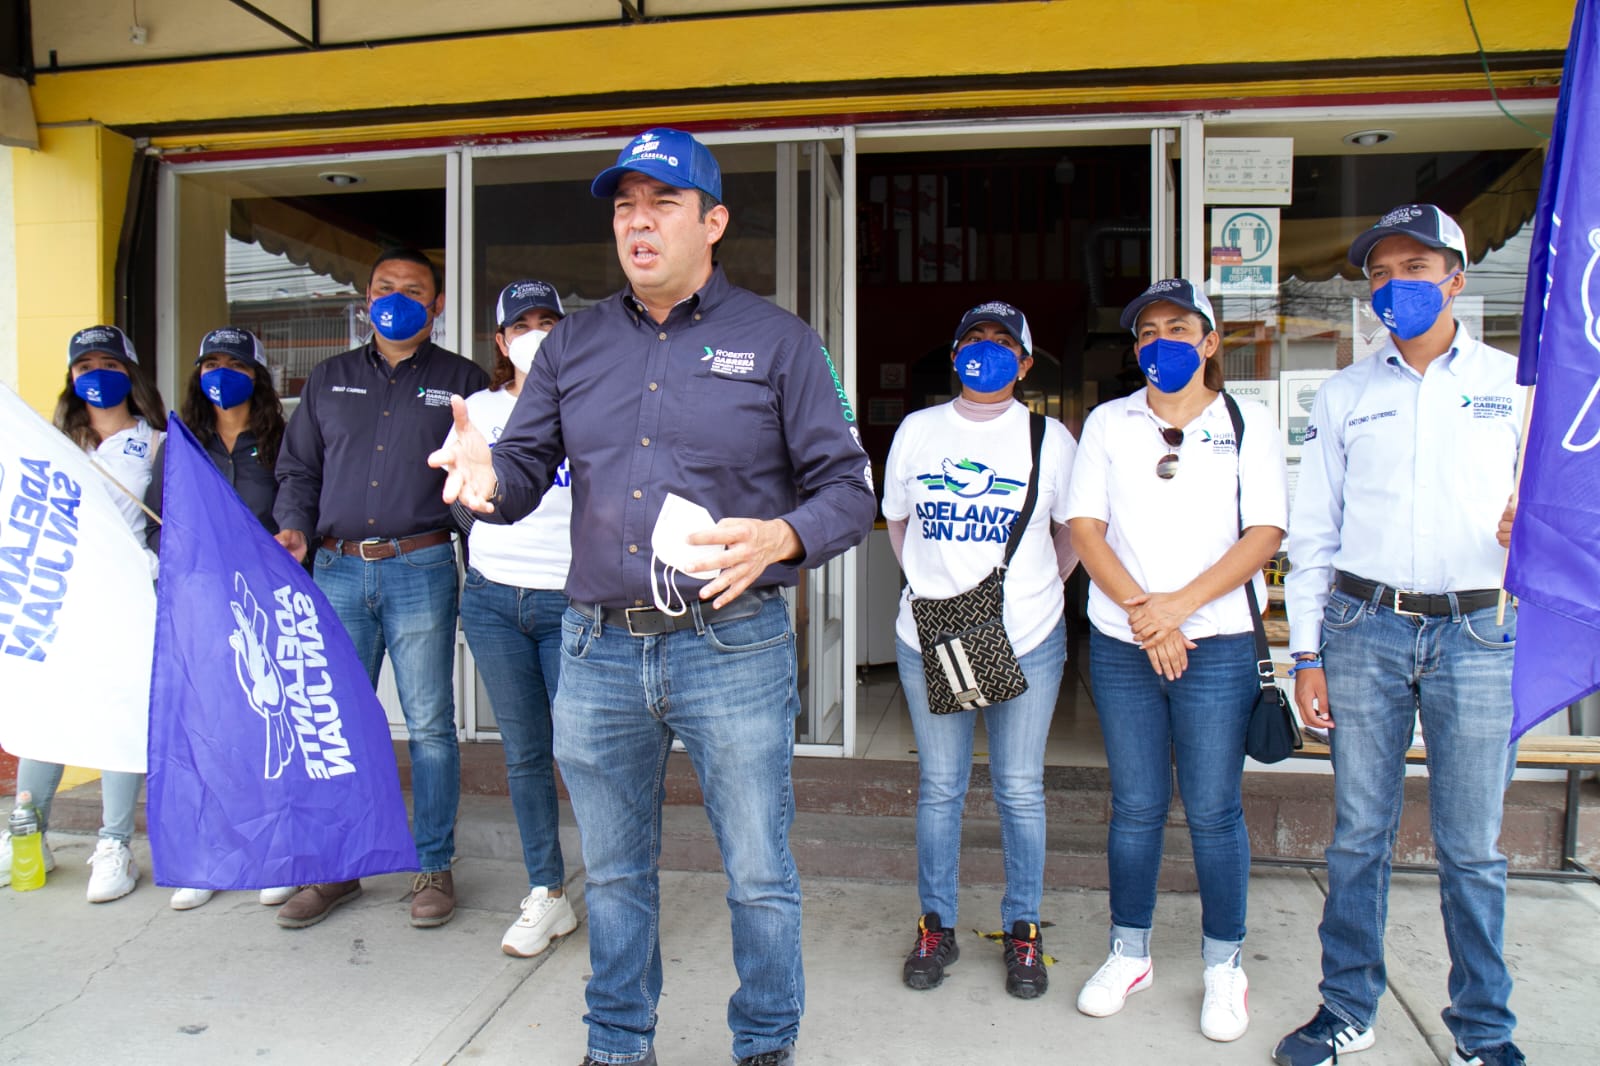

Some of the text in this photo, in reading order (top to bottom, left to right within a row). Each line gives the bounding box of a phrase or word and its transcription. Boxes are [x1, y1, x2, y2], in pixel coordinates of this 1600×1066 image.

[715, 349, 755, 359] ROBERTO
[713, 356, 754, 367] CABRERA
[1229, 387, 1261, 396] ACCESO
[1473, 395, 1513, 404] ROBERTO
[1473, 402, 1513, 412] CABRERA
[1348, 414, 1370, 427] ANTONIO
[922, 519, 954, 541] SAN
